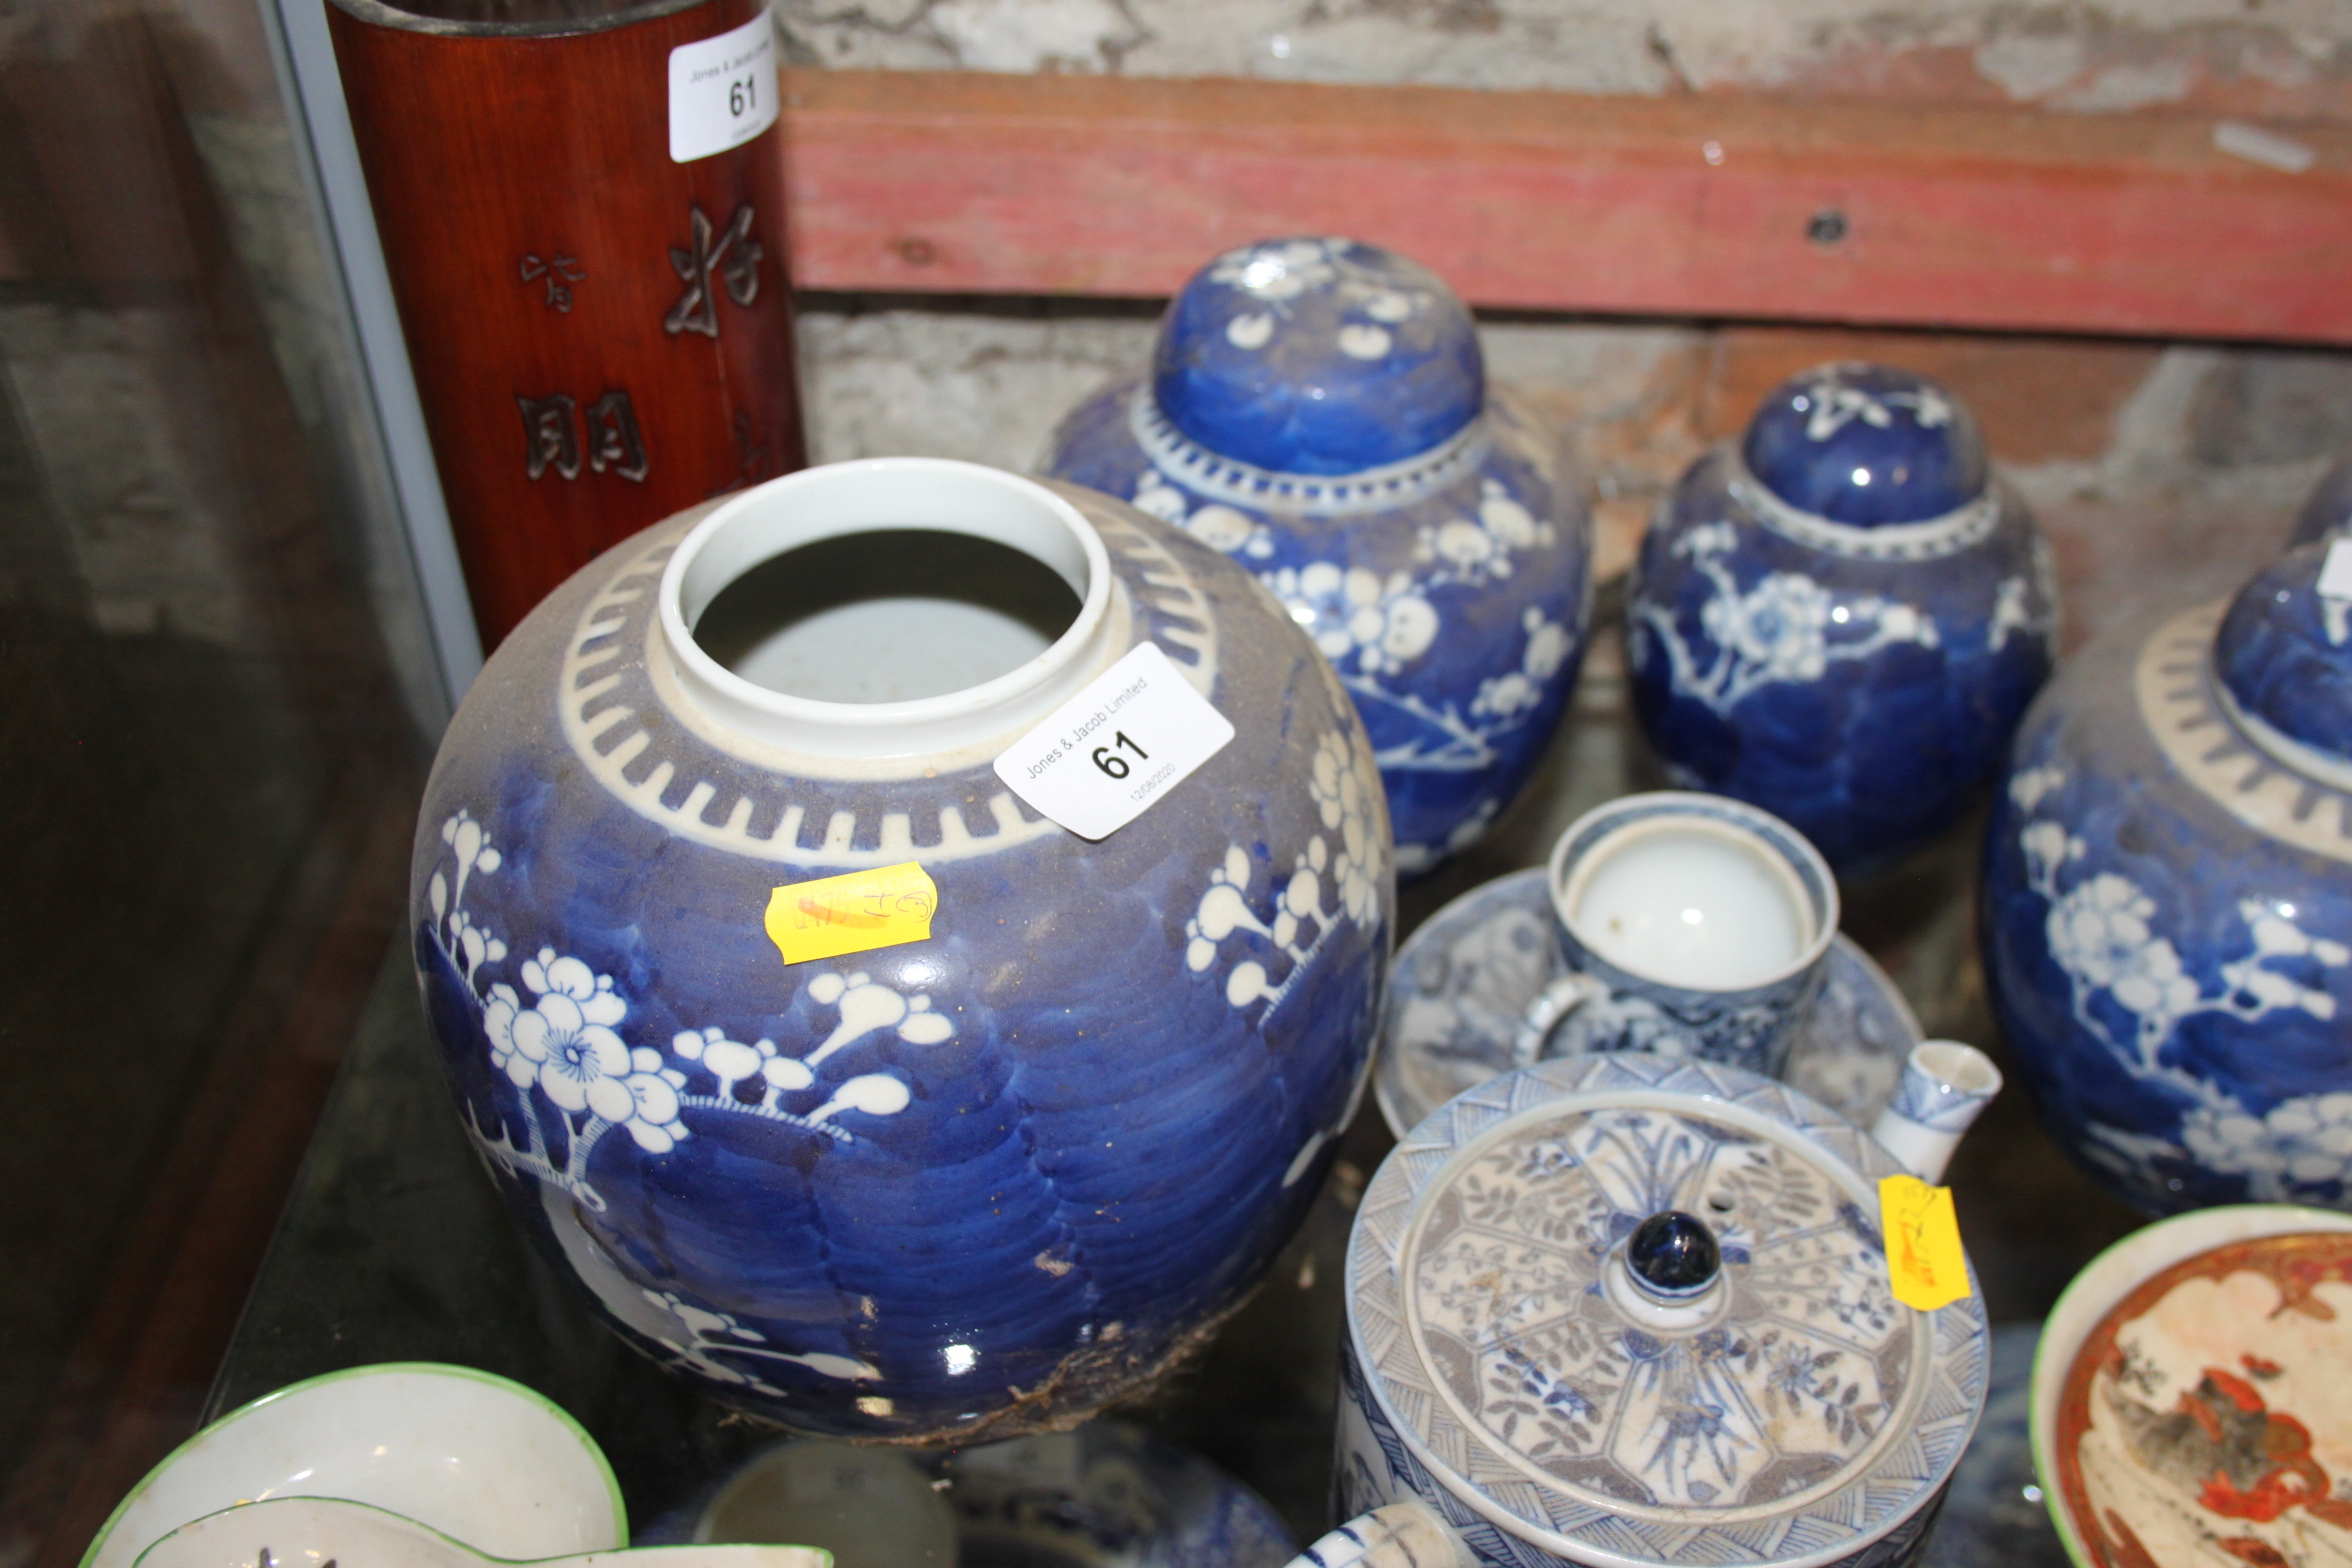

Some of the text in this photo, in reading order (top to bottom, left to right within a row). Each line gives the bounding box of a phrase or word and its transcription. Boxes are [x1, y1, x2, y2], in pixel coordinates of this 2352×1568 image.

[691, 66, 720, 83] Jones
[730, 74, 756, 117] 61
[1026, 677, 1148, 780] Jones & Jacob Limited
[1092, 730, 1149, 779] 61
[1130, 763, 1176, 803] 12/08/2020
